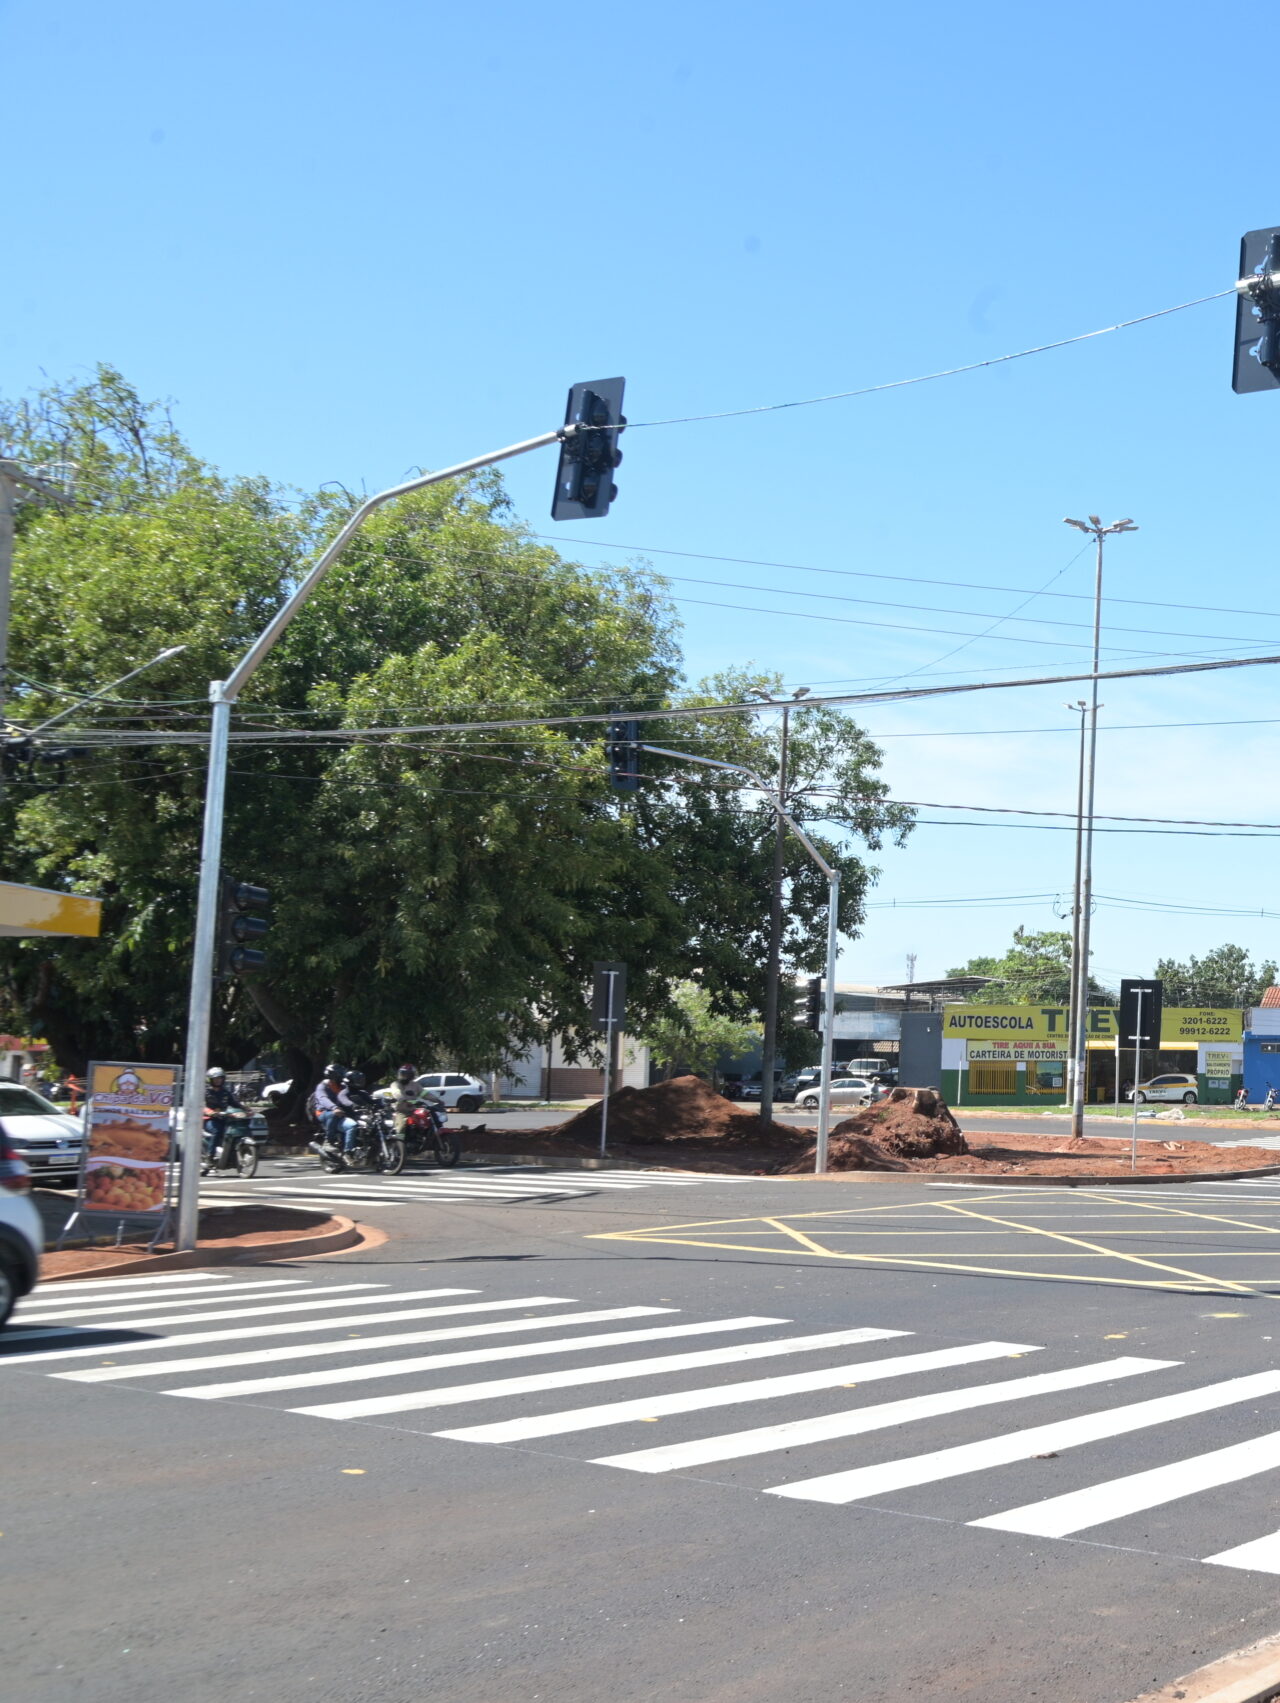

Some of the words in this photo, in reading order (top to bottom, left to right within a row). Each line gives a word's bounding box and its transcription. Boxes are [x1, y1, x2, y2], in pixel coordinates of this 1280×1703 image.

[949, 1015, 1034, 1030] AUTOESCOLA
[1182, 1017, 1228, 1025] 3201-6222
[1179, 1027, 1231, 1035] 99912-6222
[969, 1050, 1012, 1059] CARTEIRA
[1014, 1050, 1026, 1059] DE
[1027, 1050, 1069, 1059] MOTORIST
